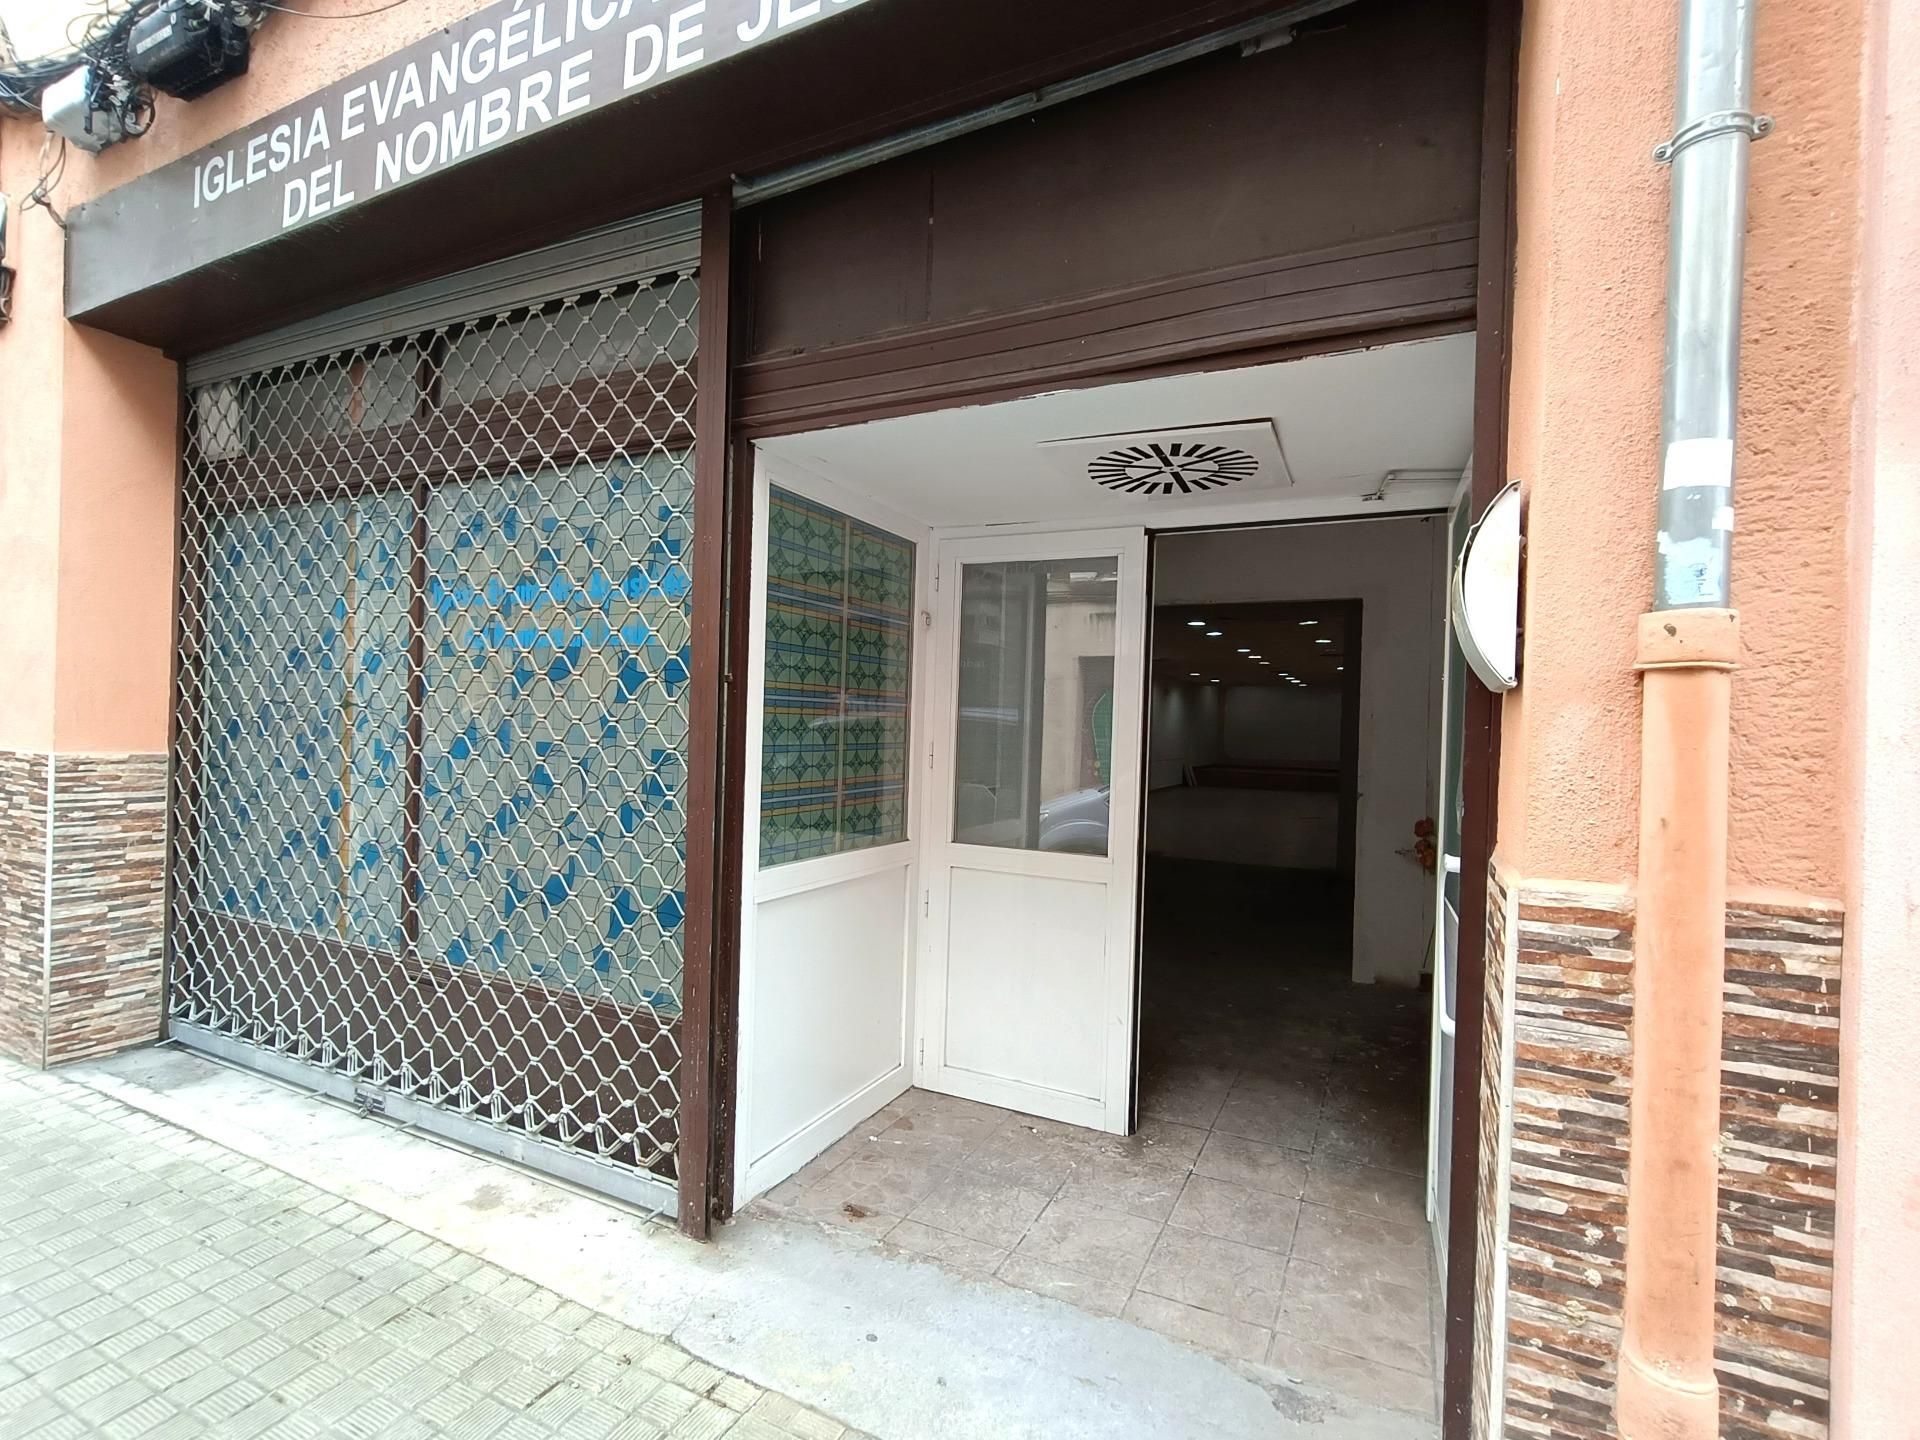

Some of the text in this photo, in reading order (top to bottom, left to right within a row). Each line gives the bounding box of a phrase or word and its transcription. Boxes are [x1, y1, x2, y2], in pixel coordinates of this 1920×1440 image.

[193, 106, 330, 208] IGLESIA
[282, 159, 354, 228] DEL
[374, 49, 592, 190] NOMBRE
[623, 0, 705, 90] DE
